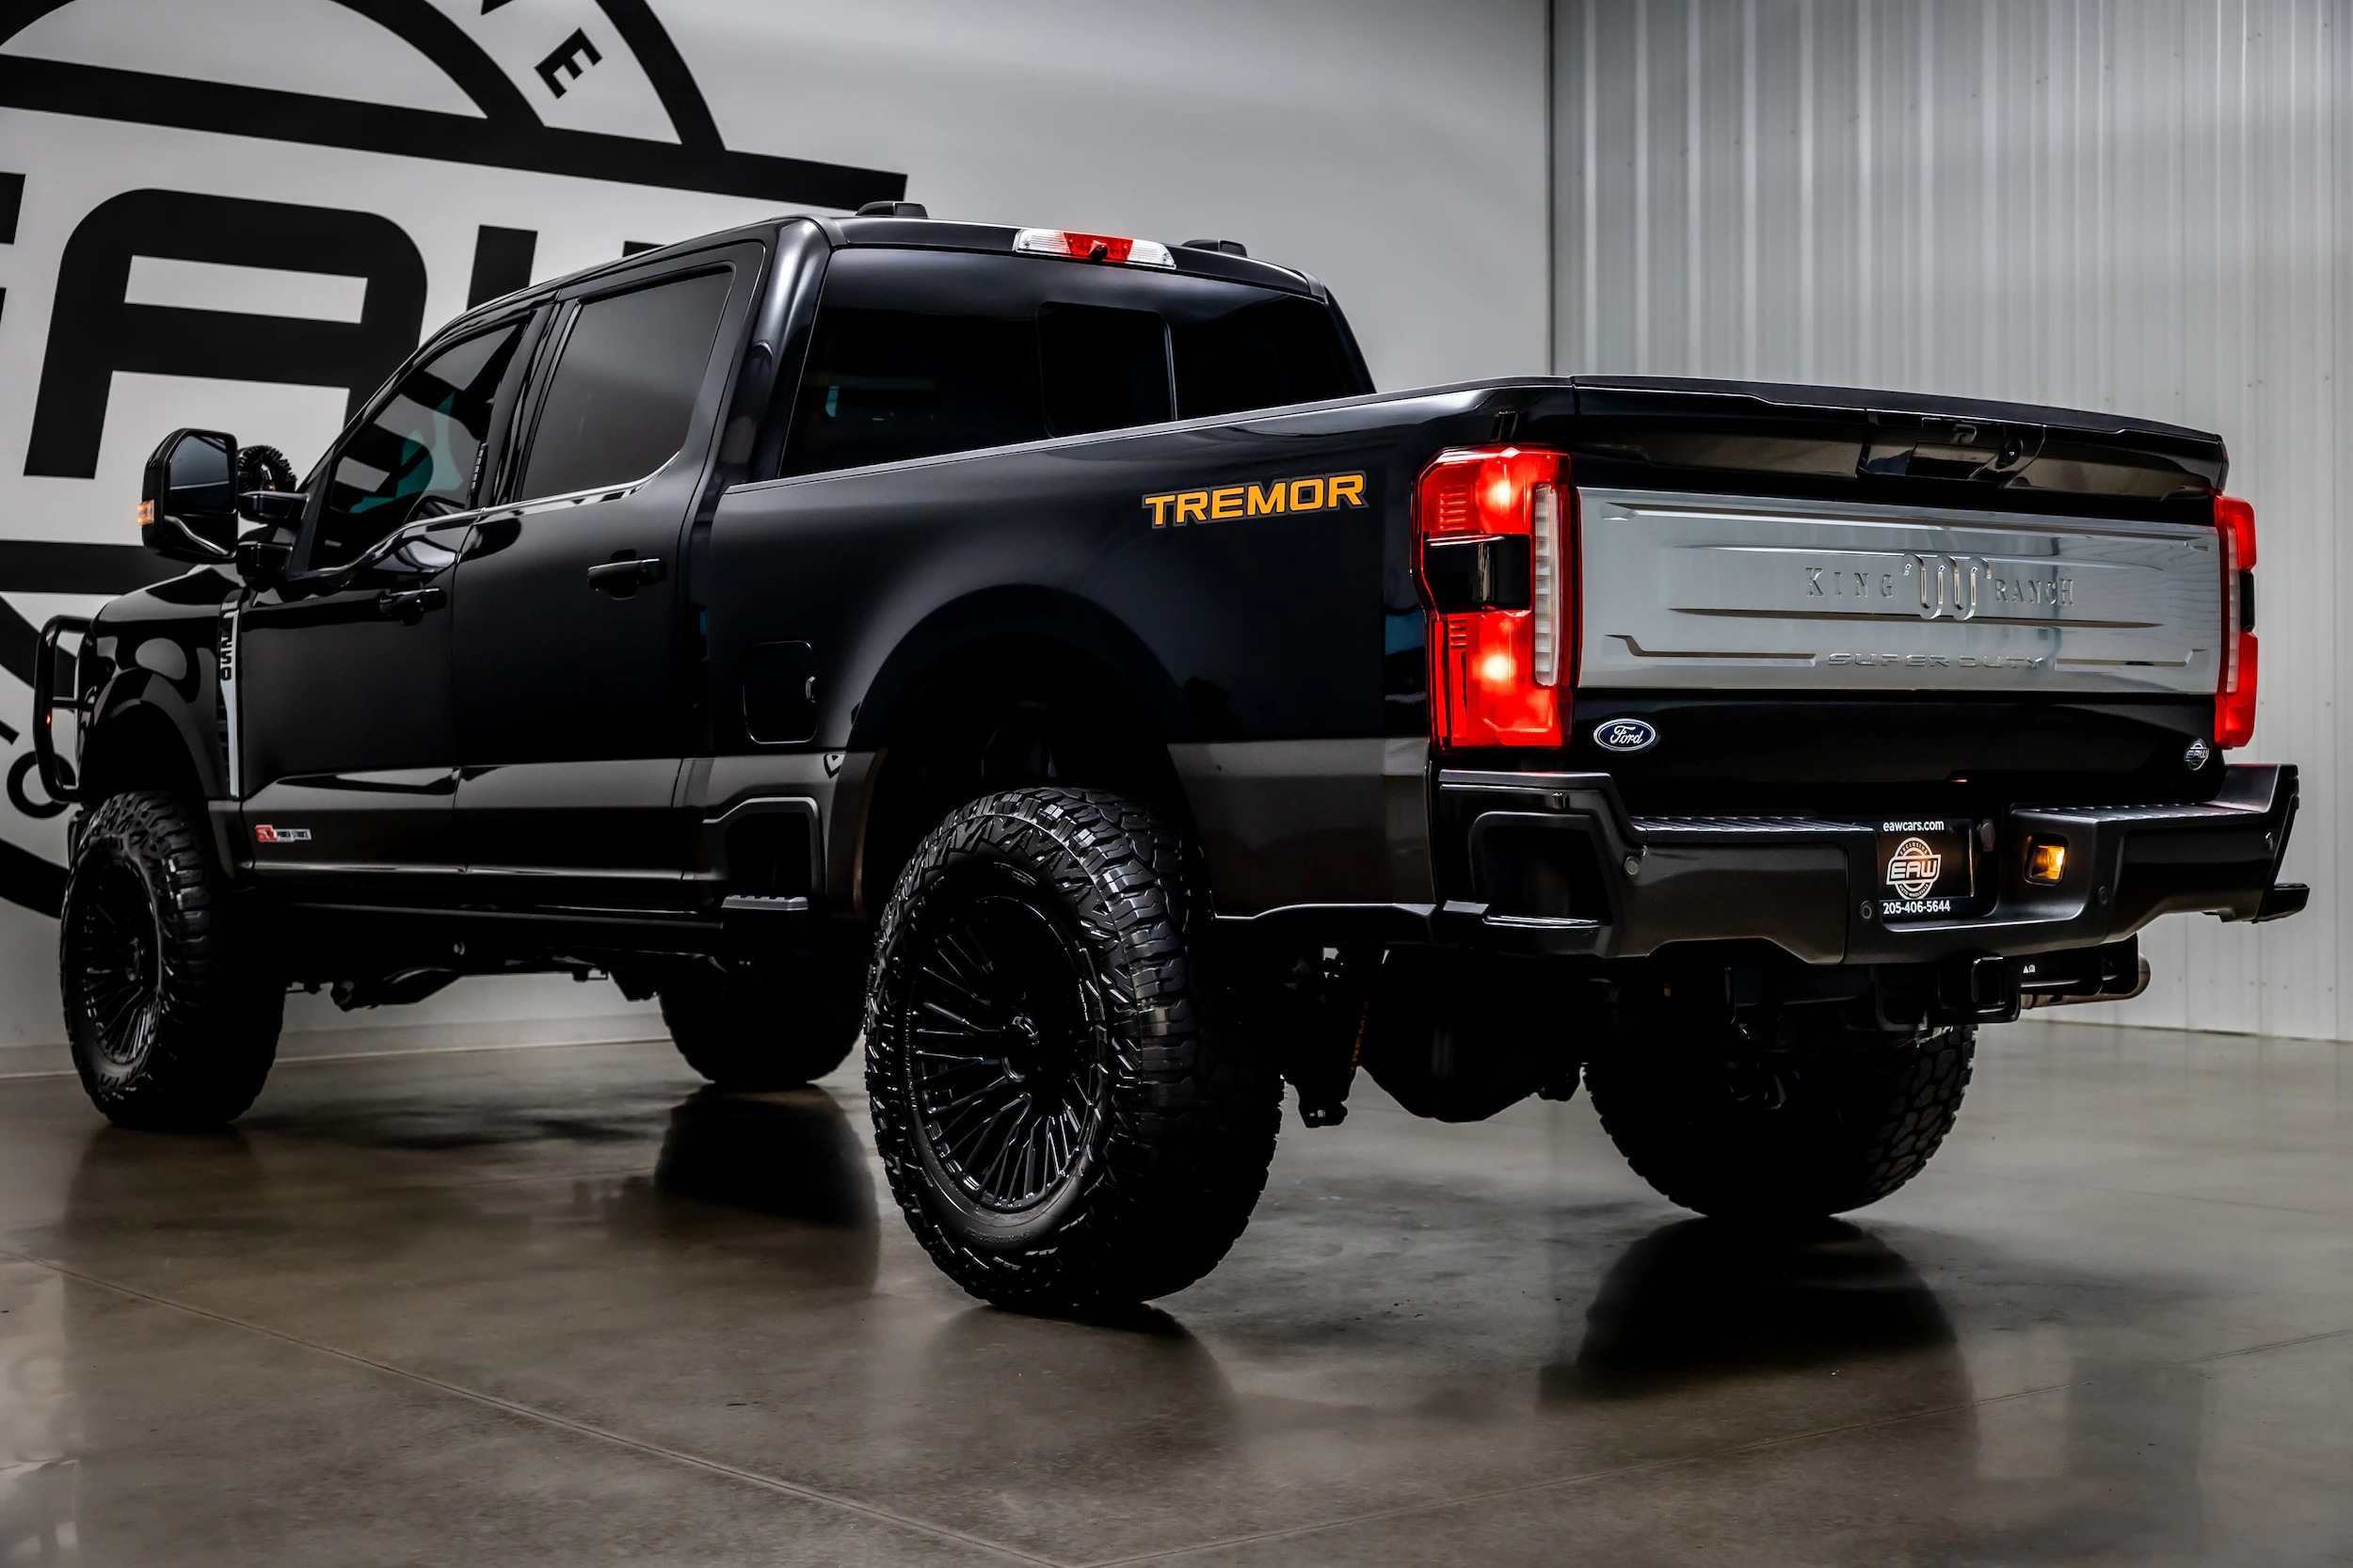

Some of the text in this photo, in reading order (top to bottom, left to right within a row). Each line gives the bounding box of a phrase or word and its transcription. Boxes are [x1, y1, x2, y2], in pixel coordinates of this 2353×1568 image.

[1143, 472, 1367, 528] TREMOR
[1805, 567, 2074, 606] KING RANCH
[1829, 652, 2044, 669] SUPER DUTY
[1609, 725, 1644, 744] Ford
[1882, 821, 1945, 832] eawcars.com
[1890, 859, 1938, 879] EAW
[1882, 900, 1952, 915] 205-406-5644
